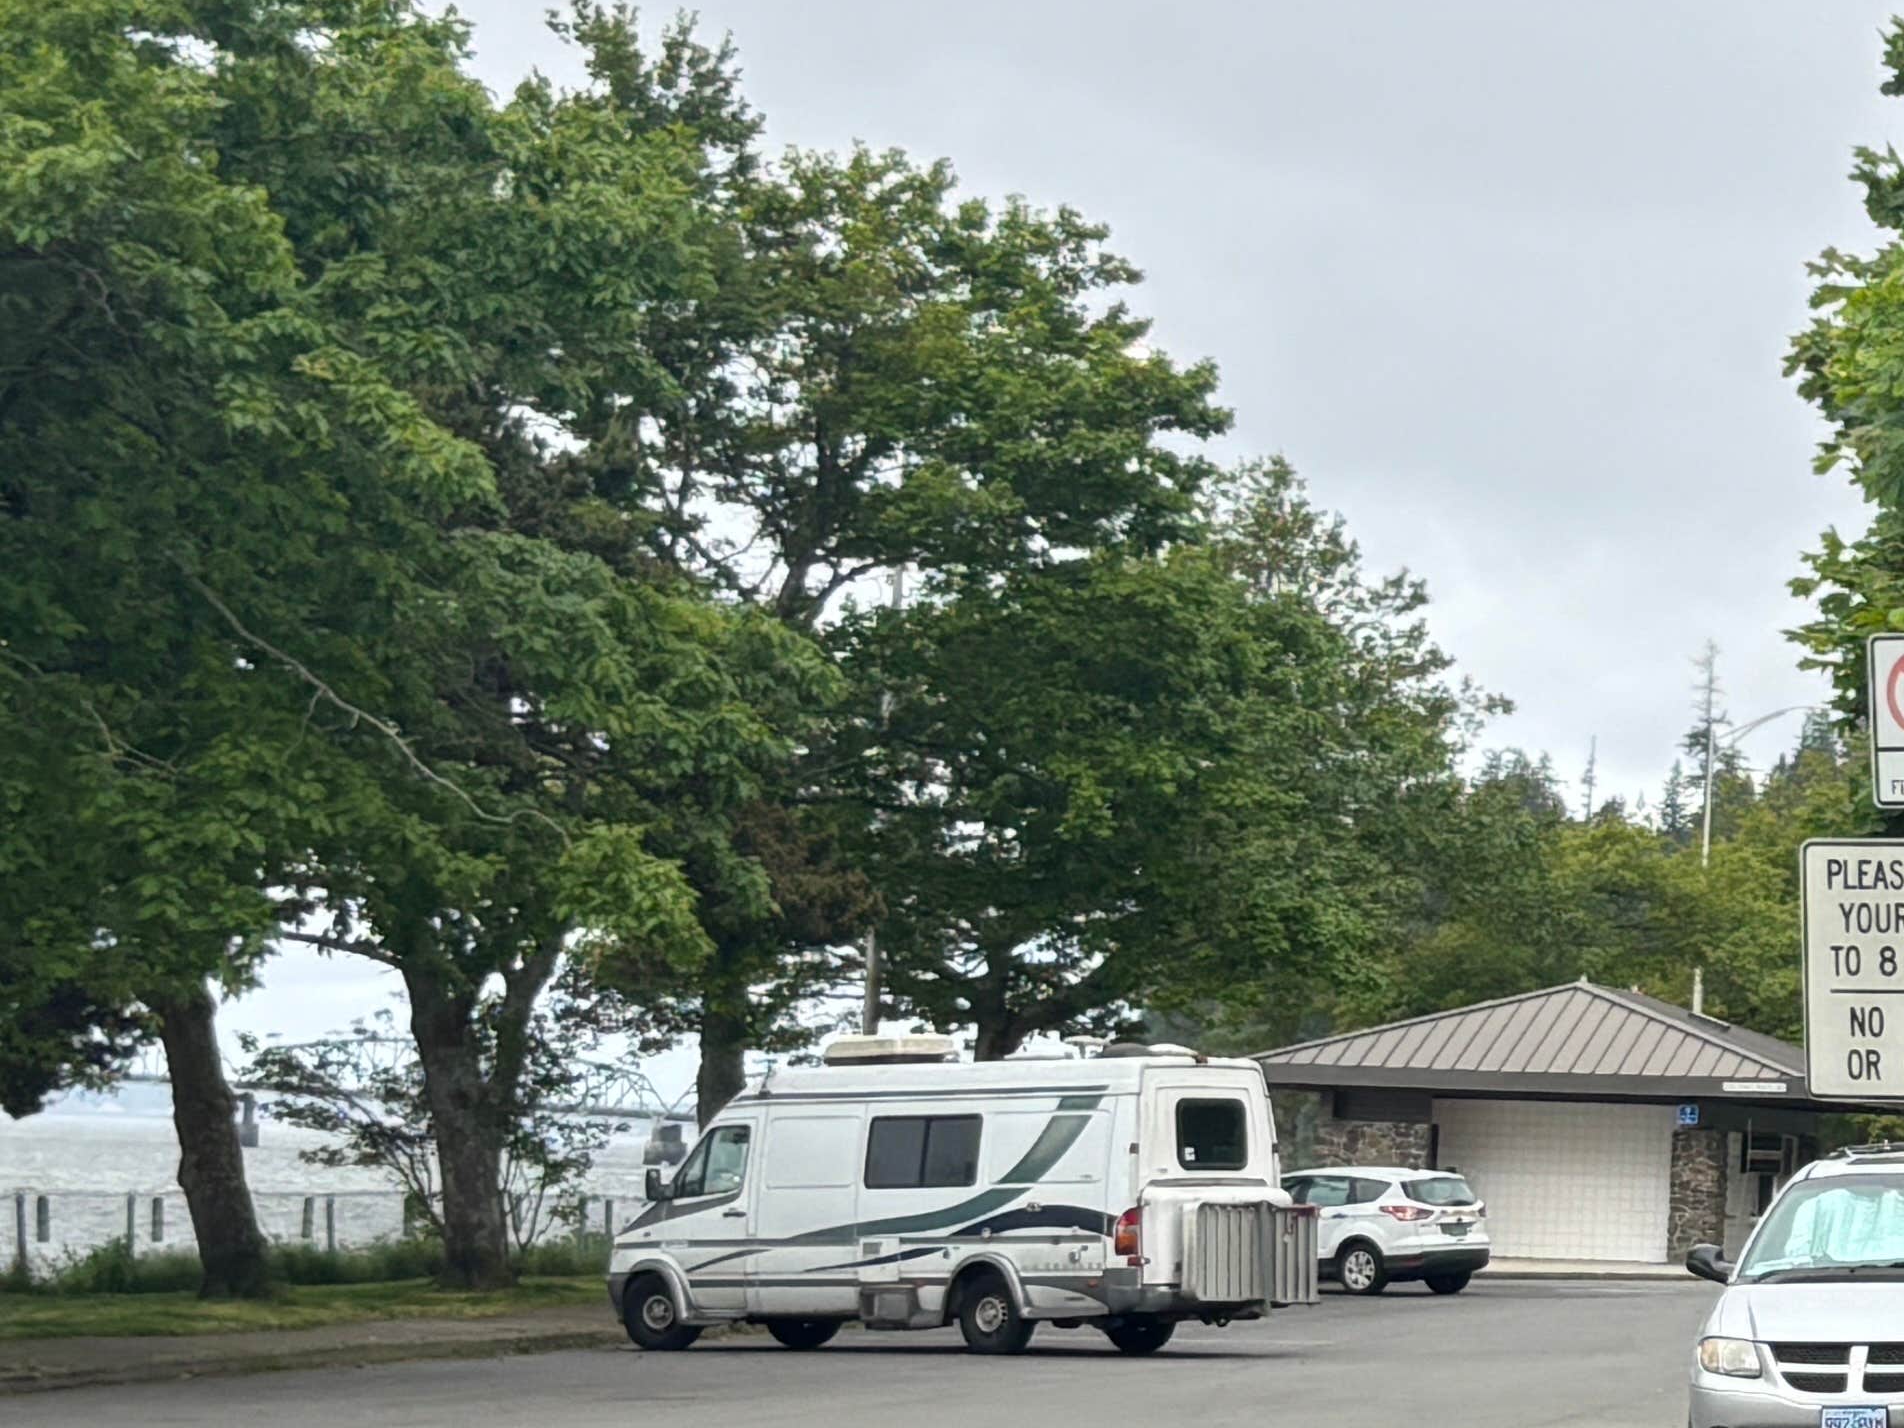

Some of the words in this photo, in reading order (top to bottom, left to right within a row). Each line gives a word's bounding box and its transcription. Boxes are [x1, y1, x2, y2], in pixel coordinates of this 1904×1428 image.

[1829, 945, 1861, 977] TO
[1879, 945, 1898, 977] 8
[1849, 1006, 1885, 1038] NO
[1847, 1048, 1881, 1081] OR
